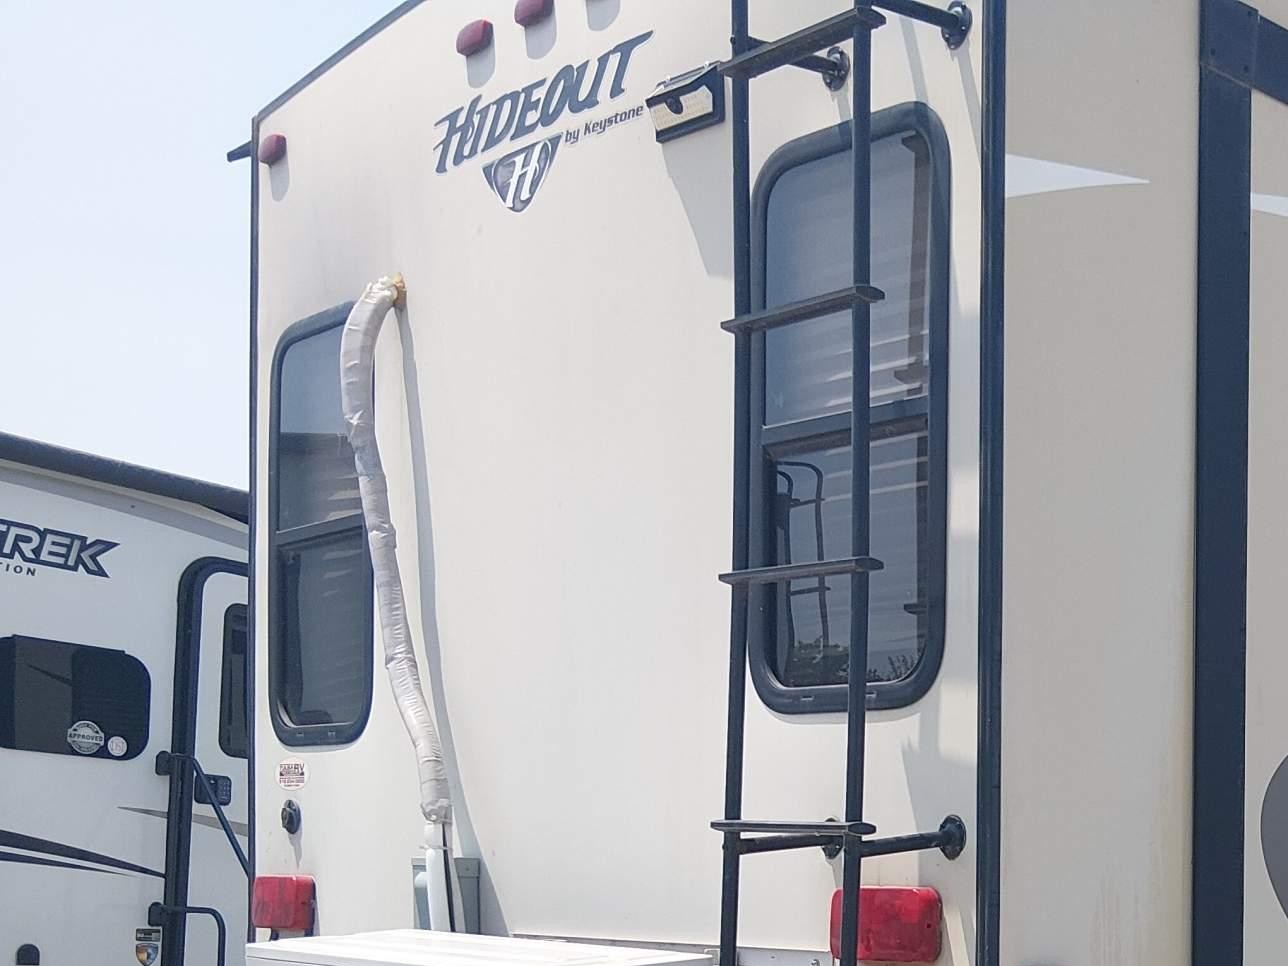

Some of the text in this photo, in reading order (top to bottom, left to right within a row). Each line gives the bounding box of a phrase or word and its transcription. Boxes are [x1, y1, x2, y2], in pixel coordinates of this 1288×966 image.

[432, 30, 655, 174] HIDEOUT
[564, 105, 644, 145] by Keystone
[0, 518, 121, 578] REK
[0, 561, 37, 577] ION
